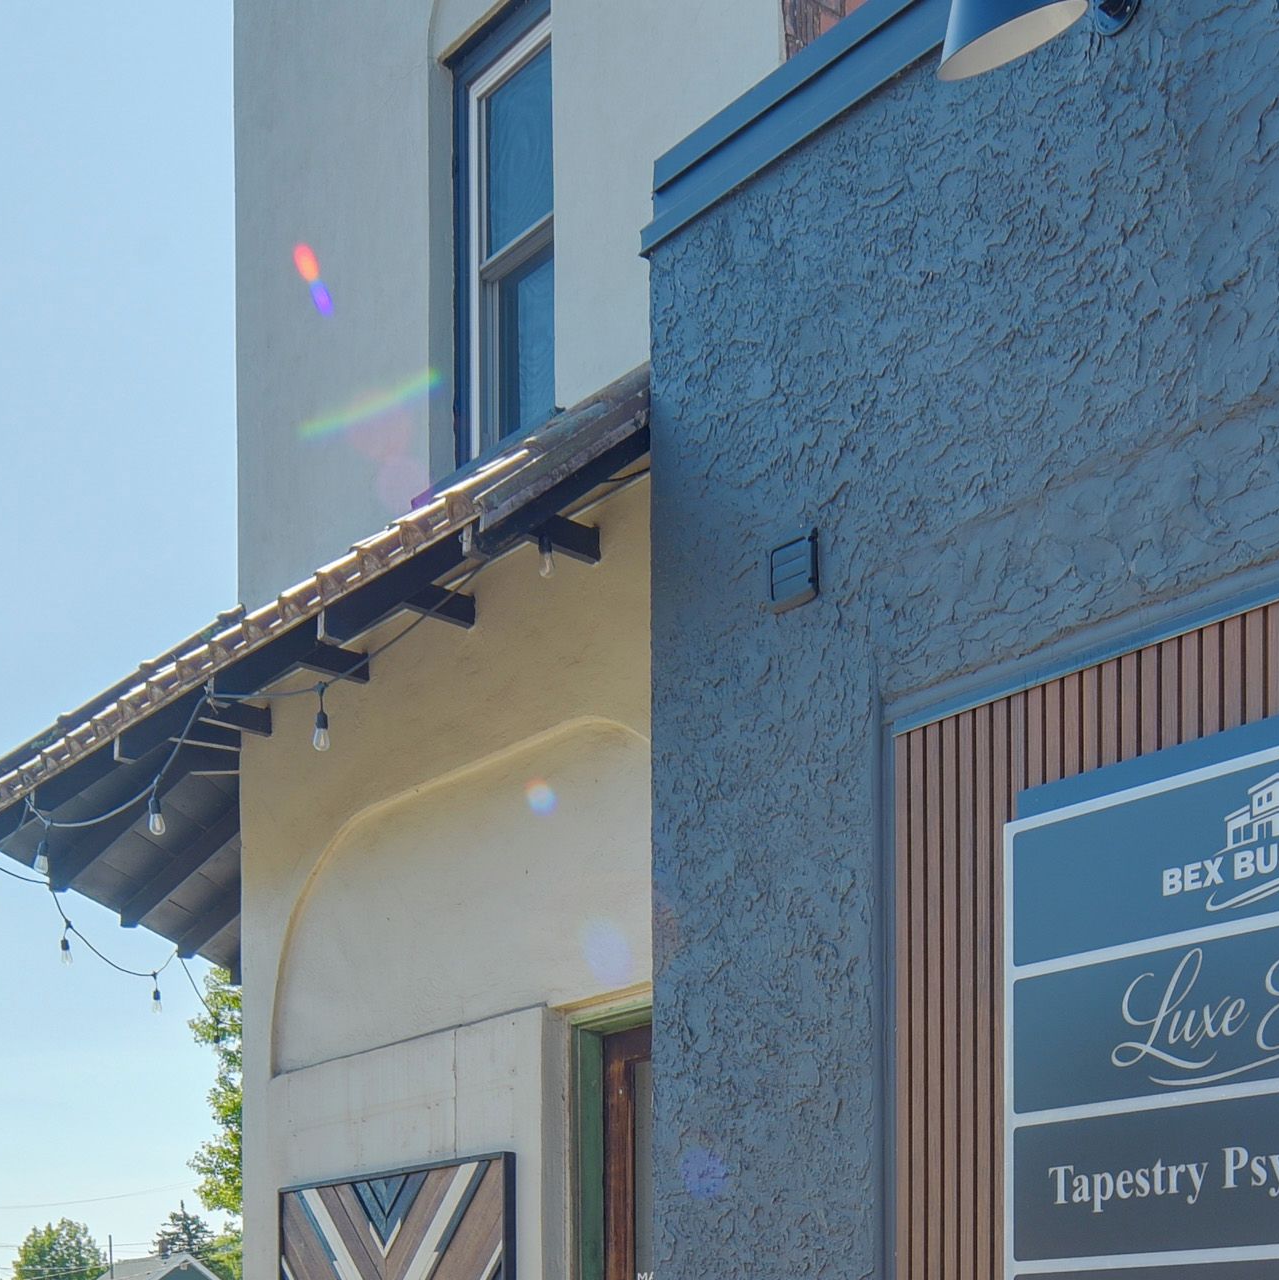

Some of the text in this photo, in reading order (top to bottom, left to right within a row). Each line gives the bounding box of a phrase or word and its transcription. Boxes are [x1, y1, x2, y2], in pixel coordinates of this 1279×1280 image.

[1162, 856, 1224, 897] BEX
[1111, 946, 1250, 1069] Luxe
[1048, 1157, 1209, 1213] Tapestry
